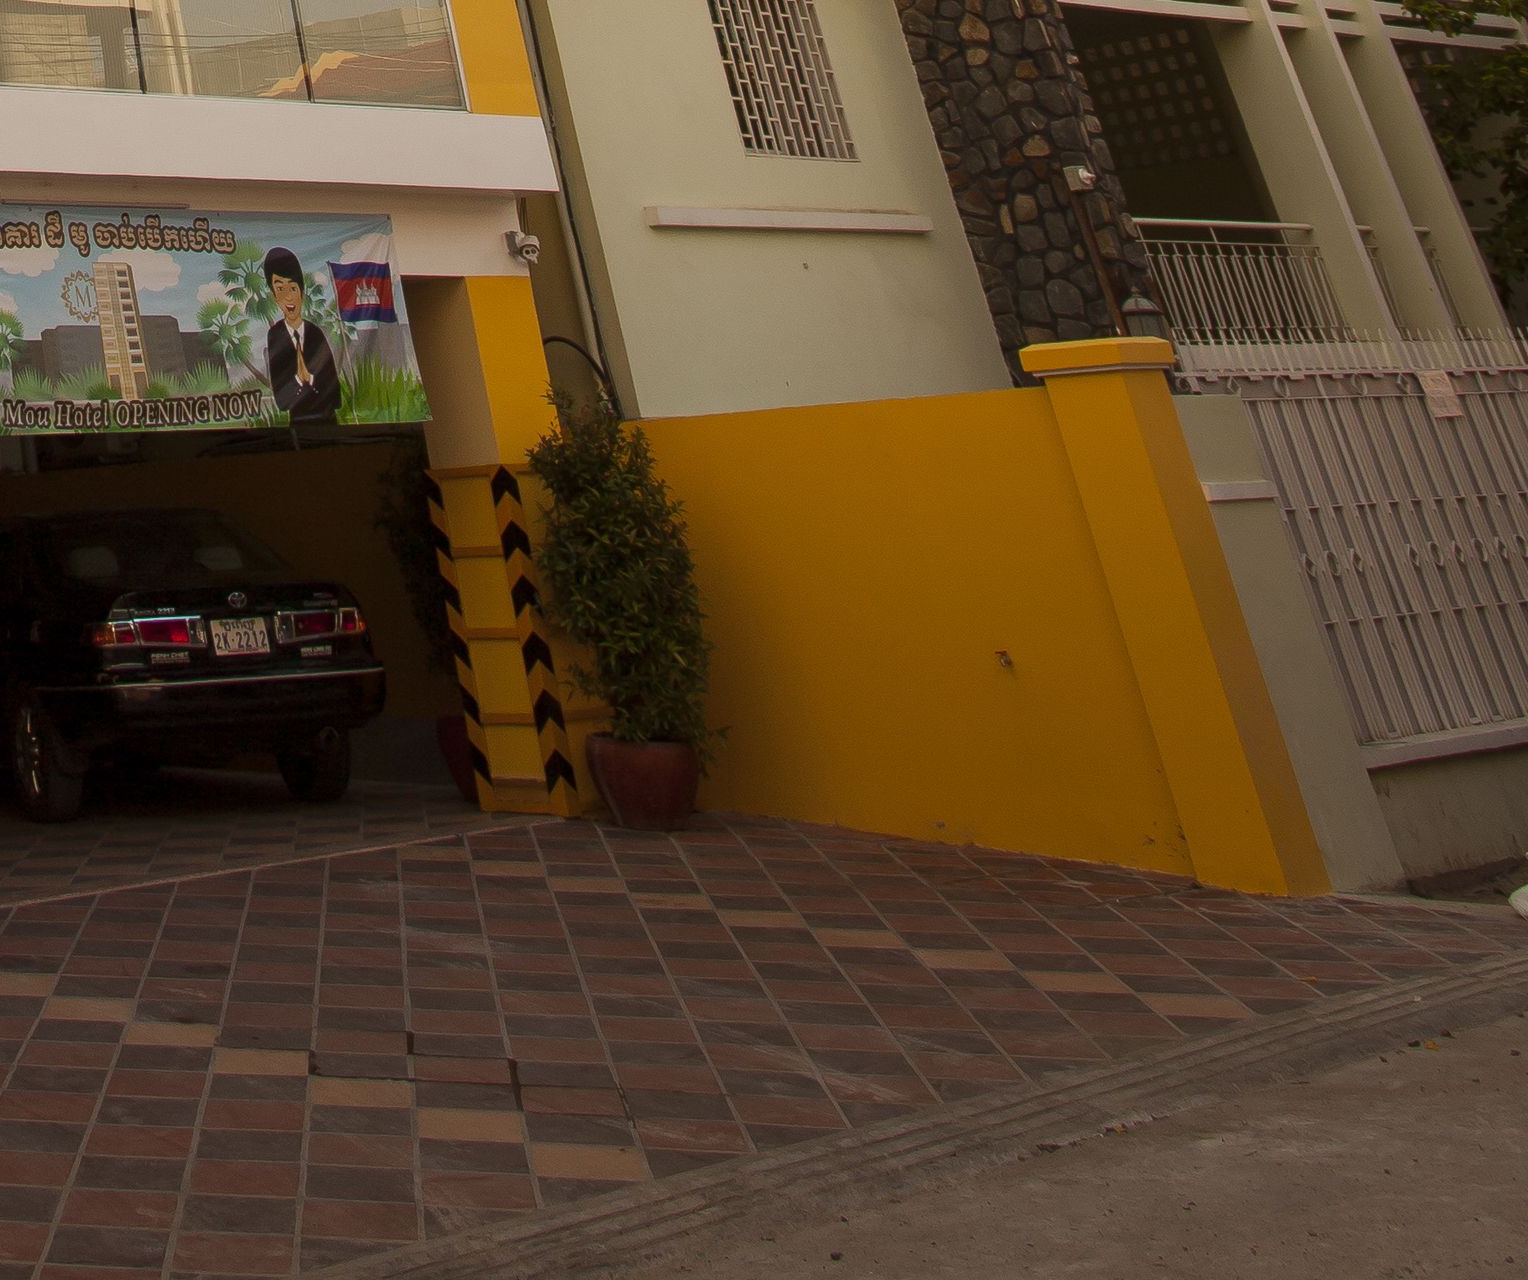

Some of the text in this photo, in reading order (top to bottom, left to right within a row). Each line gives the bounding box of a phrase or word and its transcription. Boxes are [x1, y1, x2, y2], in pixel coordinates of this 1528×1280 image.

[3, 399, 49, 427] Mou
[55, 400, 110, 428] Hotel
[114, 397, 210, 428] OPENING
[214, 390, 263, 421] NOW
